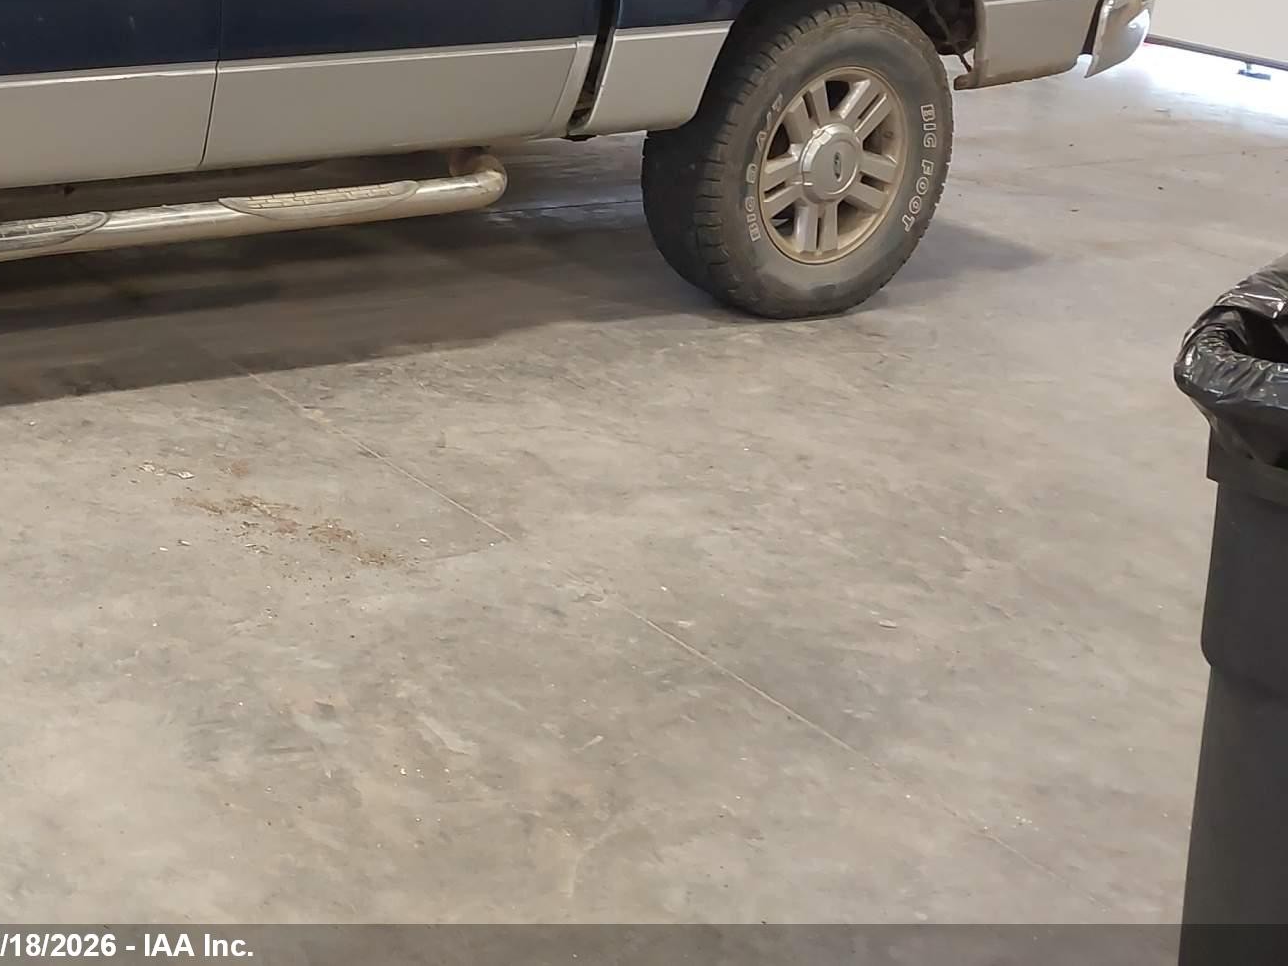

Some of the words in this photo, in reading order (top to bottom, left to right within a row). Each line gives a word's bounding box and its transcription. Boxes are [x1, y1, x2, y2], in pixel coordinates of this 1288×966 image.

[920, 103, 937, 148] BIG
[745, 195, 761, 242] BIG
[901, 159, 935, 232] FOOT
